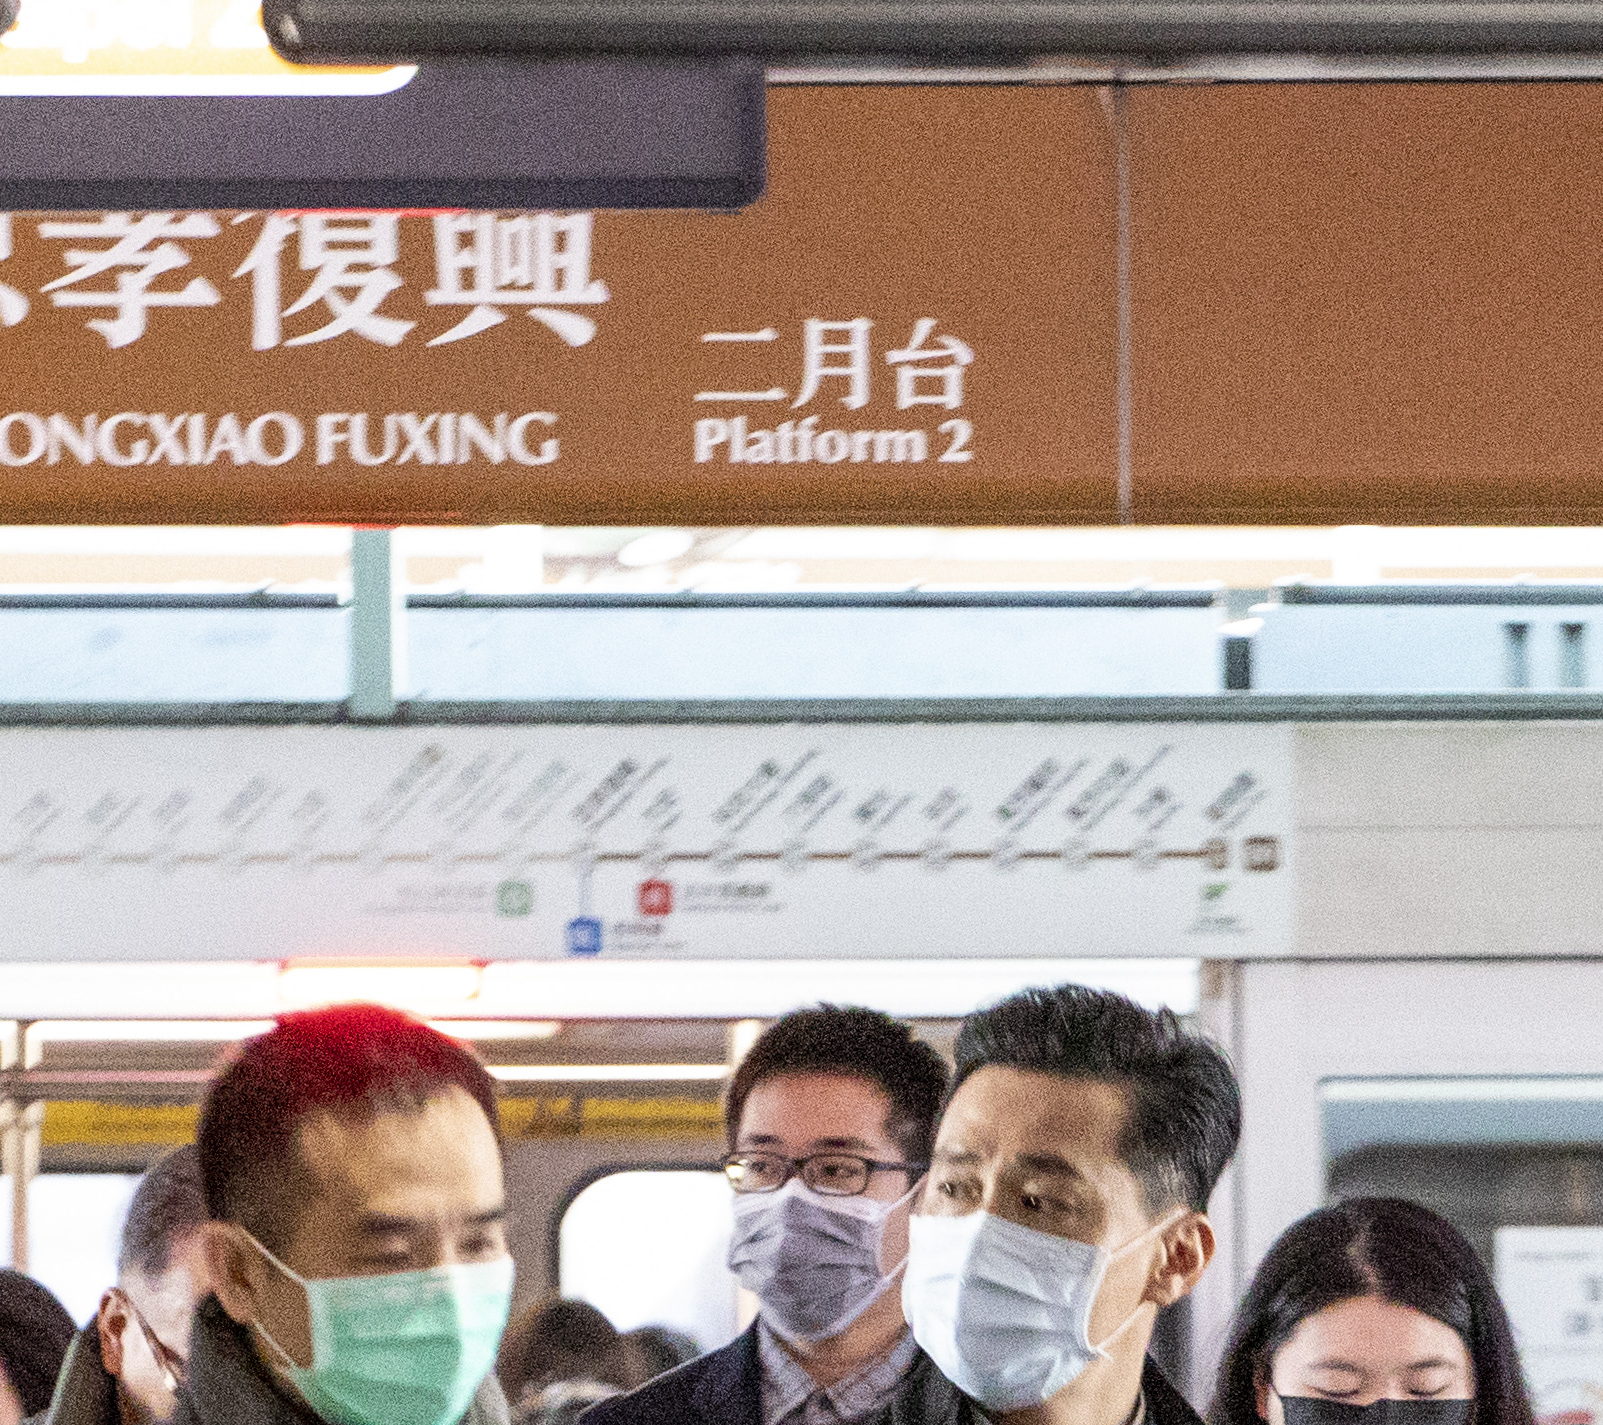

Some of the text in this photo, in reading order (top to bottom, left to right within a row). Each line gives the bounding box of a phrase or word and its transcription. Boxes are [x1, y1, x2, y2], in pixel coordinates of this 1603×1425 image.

[694, 317, 975, 410] 二月台
[315, 411, 560, 467] FUXING
[693, 416, 974, 465] Platform 2
